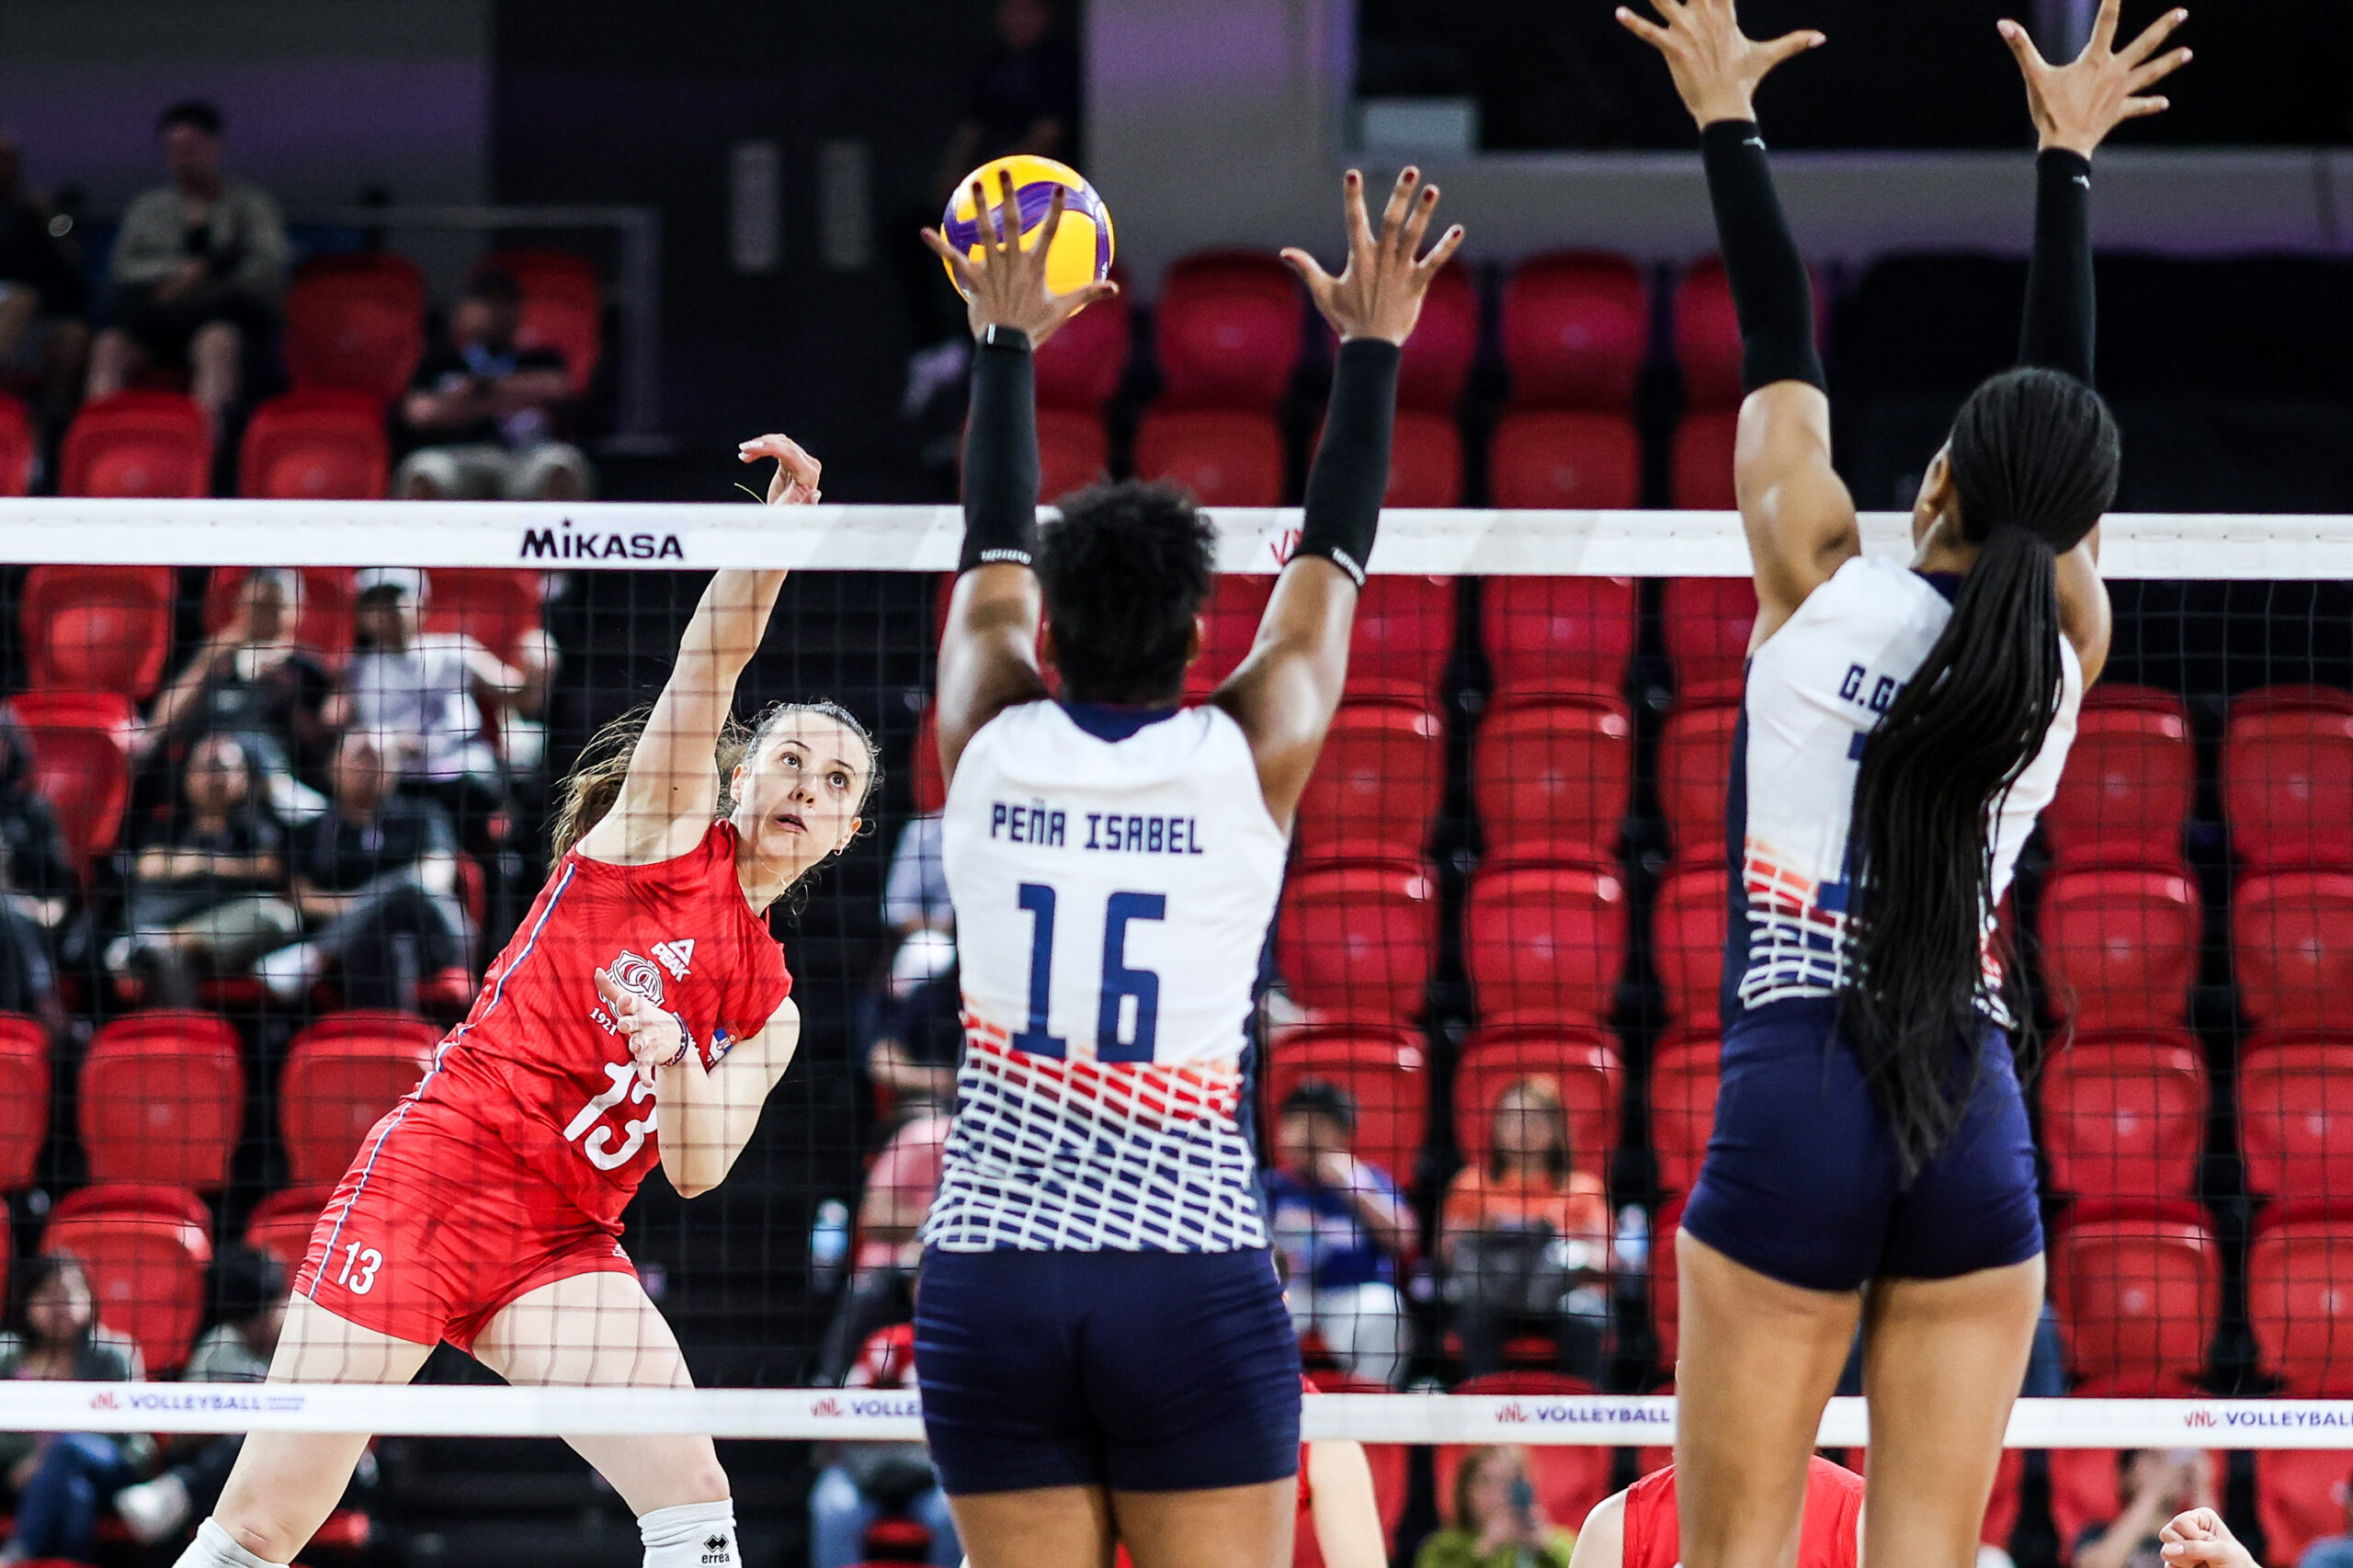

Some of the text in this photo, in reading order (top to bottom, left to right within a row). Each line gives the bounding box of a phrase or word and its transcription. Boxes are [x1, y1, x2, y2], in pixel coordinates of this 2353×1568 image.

[992, 798, 1202, 854] PEÑA ISABEL
[650, 940, 691, 983] PEAK
[1012, 882, 1165, 1062] 16
[588, 1006, 618, 1036] 1921
[563, 1061, 658, 1171] 13
[337, 1241, 383, 1295] 13
[129, 1393, 262, 1410] VOLLEYBALL
[1536, 1405, 1670, 1422] VOLLEYBALL
